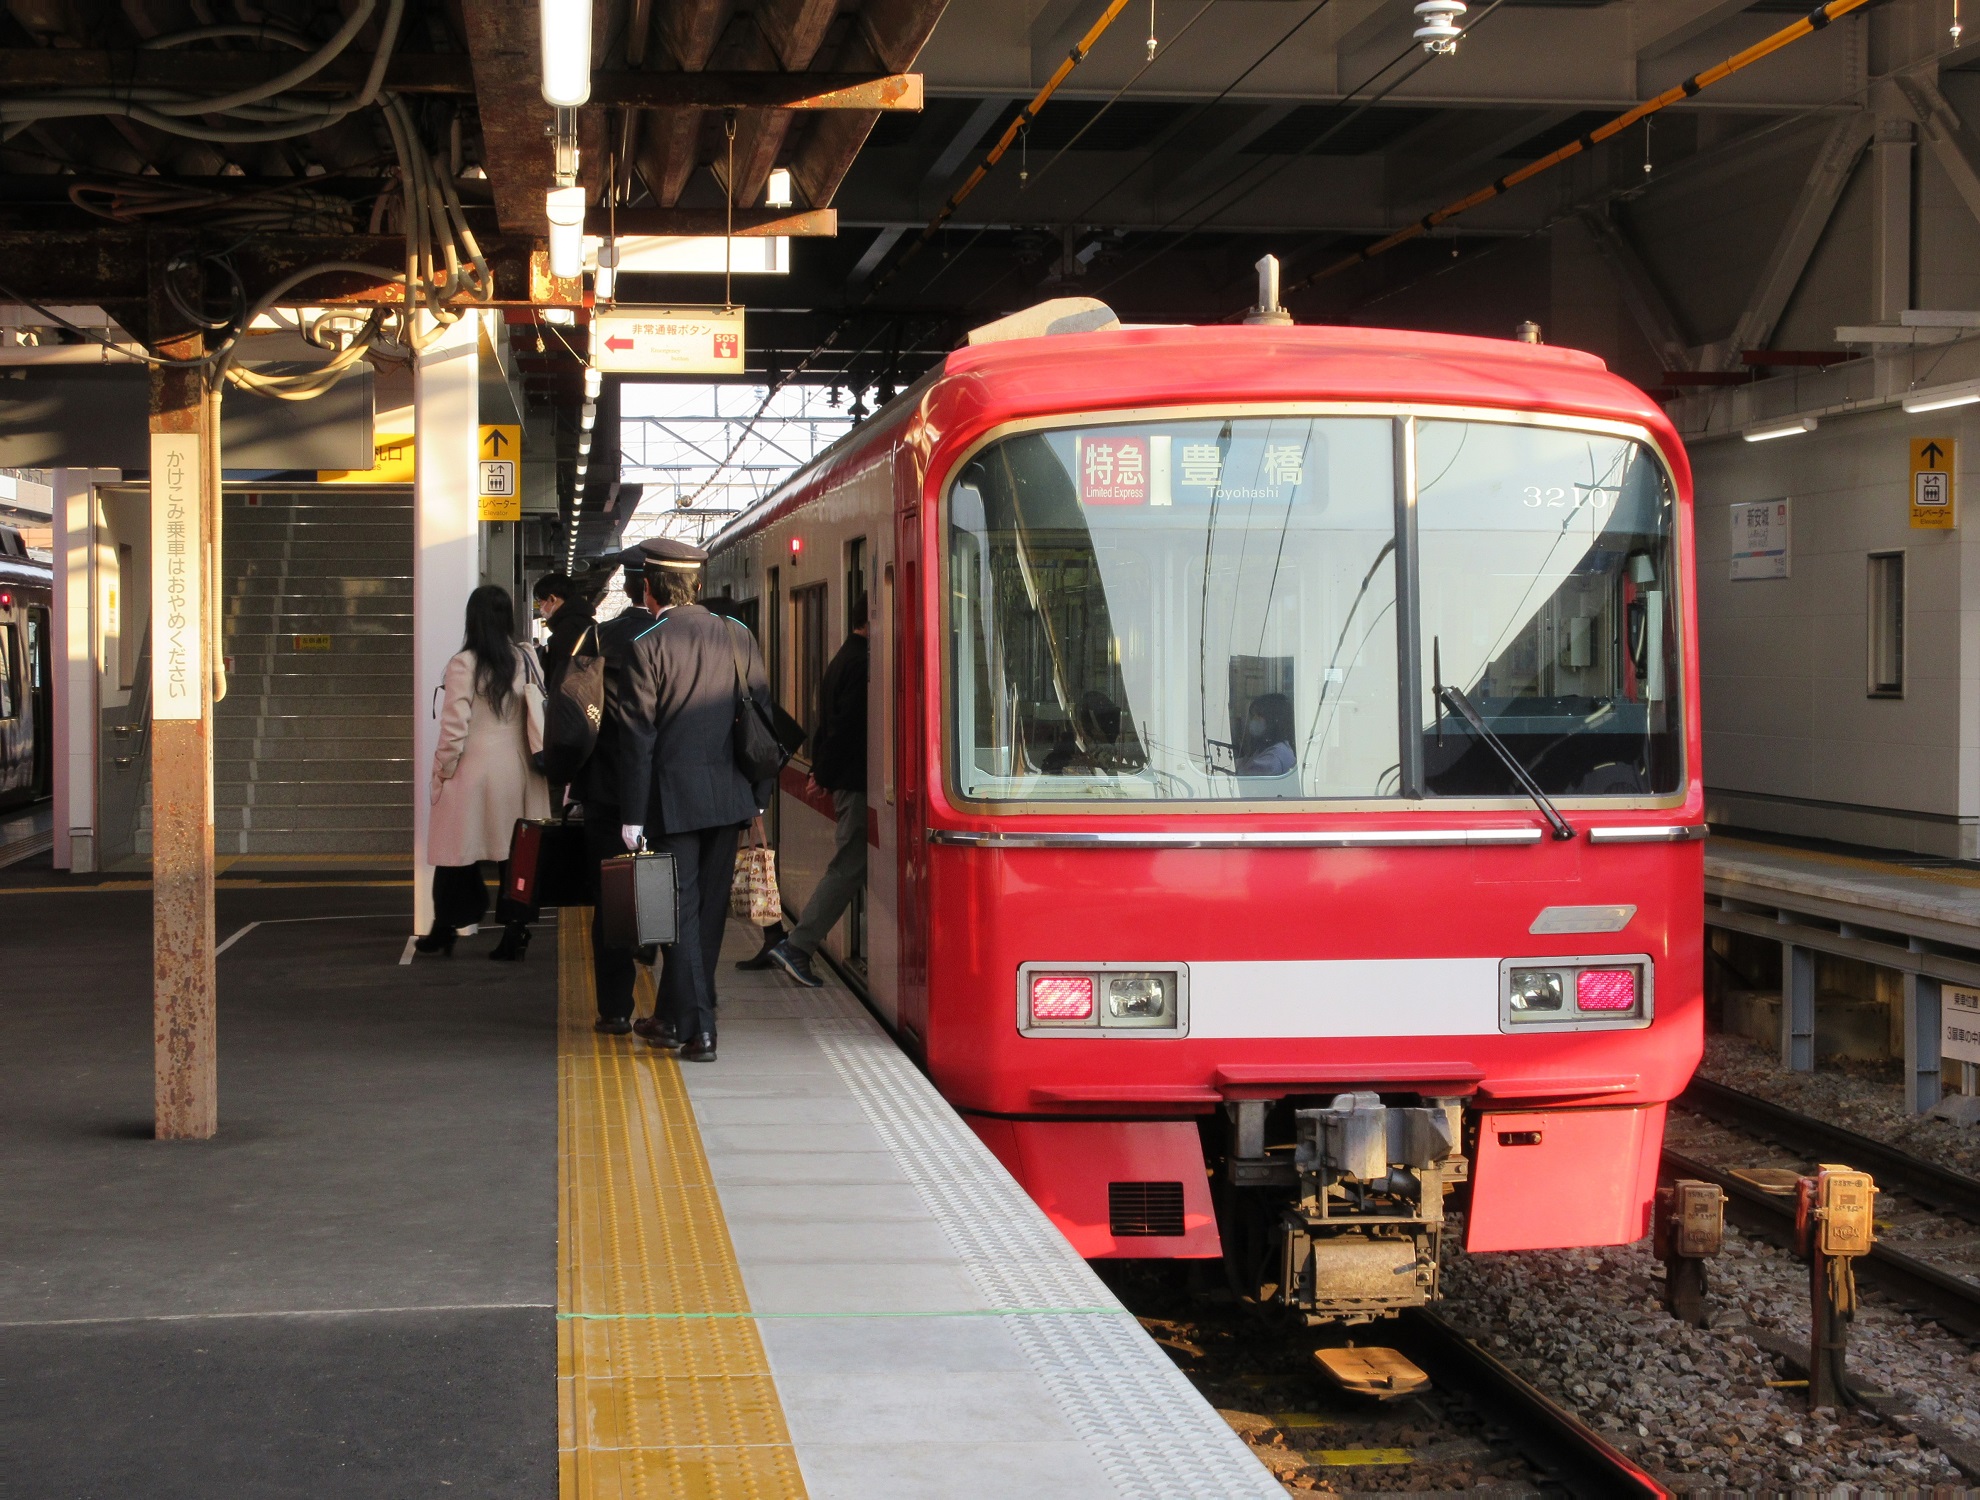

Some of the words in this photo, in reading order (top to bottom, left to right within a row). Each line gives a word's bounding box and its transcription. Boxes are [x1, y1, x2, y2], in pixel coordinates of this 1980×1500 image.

[632, 324, 712, 336] 非常通報ボタン
[716, 334, 736, 342] SOS
[1086, 443, 1145, 485] 特急
[1181, 443, 1304, 486] 豊橋
[1086, 487, 1114, 499] Limited
[1114, 487, 1144, 500] Express
[1207, 487, 1280, 500] Toyohashi
[1522, 486, 1611, 508] 3210
[1913, 509, 1951, 517] エレベーター
[166, 450, 186, 698] かけこみ乗車はおやめください
